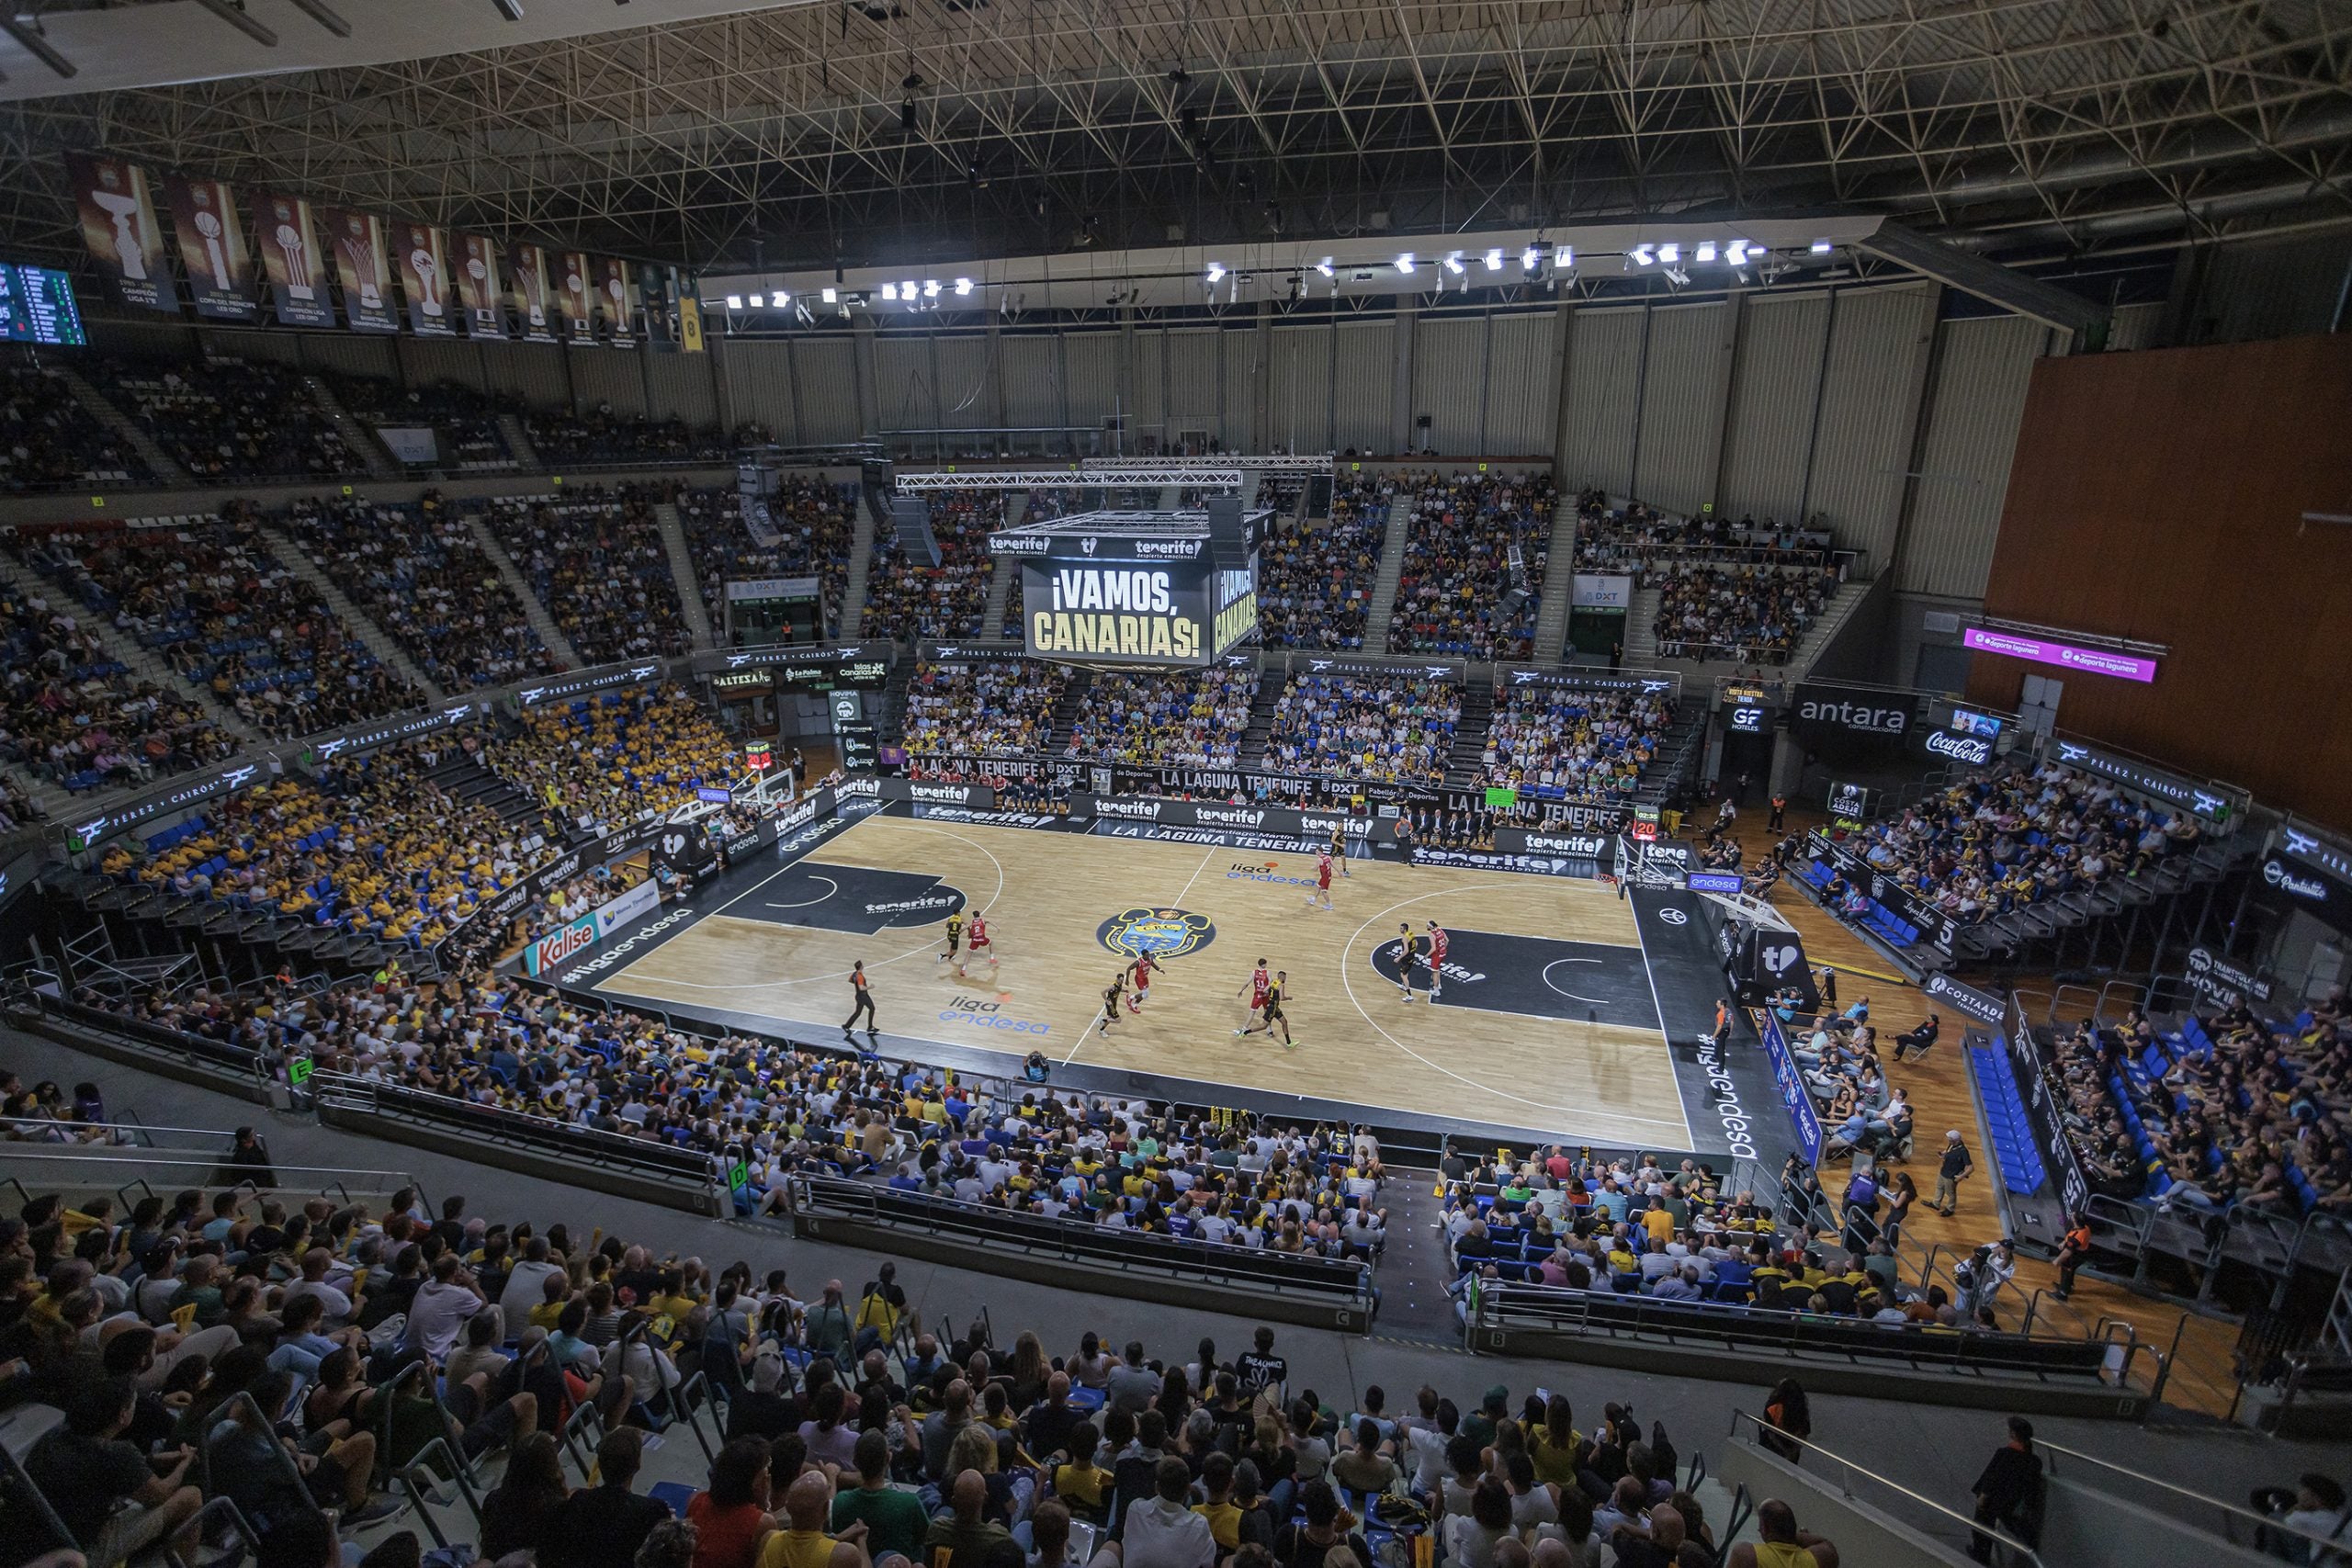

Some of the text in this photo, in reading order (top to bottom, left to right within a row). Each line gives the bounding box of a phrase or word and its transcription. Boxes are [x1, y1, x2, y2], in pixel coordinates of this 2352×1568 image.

[128, 295, 143, 303] LIGA
[199, 297, 216, 305] COPA
[1052, 569, 1178, 616] ¡VAMOS,
[1596, 592, 1618, 601] DXT
[1033, 611, 1199, 659] CANARIAS!
[962, 649, 991, 657] PÉREZ
[1990, 640, 2040, 655] deporte lagunero
[755, 653, 787, 662] PÉREZ
[2079, 657, 2137, 673] deporte lagunero
[1338, 663, 1371, 672] PÉREZ
[718, 673, 760, 687] ALTESA
[1544, 676, 1580, 685] PÉREZ
[549, 682, 582, 695] PÉREZ
[1733, 708, 1762, 725] GF
[1799, 700, 1905, 730] antara
[1731, 723, 1758, 733] HOTELES
[1848, 722, 1902, 735] construcciones
[352, 730, 390, 747] PÉREZ
[977, 761, 1038, 777] TENERIFE
[1056, 764, 1082, 774] DXT
[1125, 770, 1153, 778] Deportes
[2090, 758, 2129, 778] PÉREZ
[834, 779, 881, 799] tenerife!
[1161, 770, 1313, 796] LA LAGUNA TENERIFE
[1331, 784, 1360, 795] DXT
[699, 790, 729, 799] endesa
[910, 784, 970, 805] tenerife!
[1408, 792, 1439, 802] Deportes
[1833, 796, 1860, 807] COSTA
[1094, 799, 1161, 820] tenerife!
[1448, 794, 1467, 811] LA
[1832, 802, 1859, 815] ADEJE
[113, 803, 155, 827] PÉREZ
[775, 798, 816, 832] tenerife!
[928, 806, 1056, 828] tenerife!
[1096, 810, 1123, 818] despierta
[1195, 807, 1265, 829] tenerife!
[1159, 823, 1204, 833] Pabellón
[1208, 827, 1256, 837] Santiago
[1224, 821, 1255, 829] emociones
[1301, 815, 1374, 839] teneife!
[1637, 822, 1656, 834] 20
[605, 829, 637, 849] ARMAS
[782, 818, 846, 852] endesa
[1111, 826, 1332, 854] LA LAGUNA TENERIFE
[1807, 830, 1830, 851] SPRING
[728, 834, 761, 855] endesa
[1525, 833, 1605, 858] tenerife!
[1413, 847, 1567, 874] tenerife!
[1525, 848, 1593, 858] despierta emociones
[538, 853, 580, 887] tenerife!
[1231, 863, 1272, 874] liga
[1227, 873, 1317, 887] endesa
[1635, 883, 1668, 891] endesa
[1690, 876, 1738, 891] endesa
[865, 896, 957, 912] tenerife!
[1939, 919, 1956, 944] 5
[537, 923, 593, 974] Kalise
[560, 907, 693, 985] #ligaendesa
[949, 996, 1001, 1012] liga
[1956, 1000, 1996, 1023] TENERIFE SUR
[938, 1010, 1051, 1035] endesa
[297, 1064, 308, 1077] E
[1336, 1142, 1344, 1154] 5
[735, 1168, 743, 1183] D
[1339, 1313, 1348, 1324] C
[1494, 1333, 1503, 1345] B
